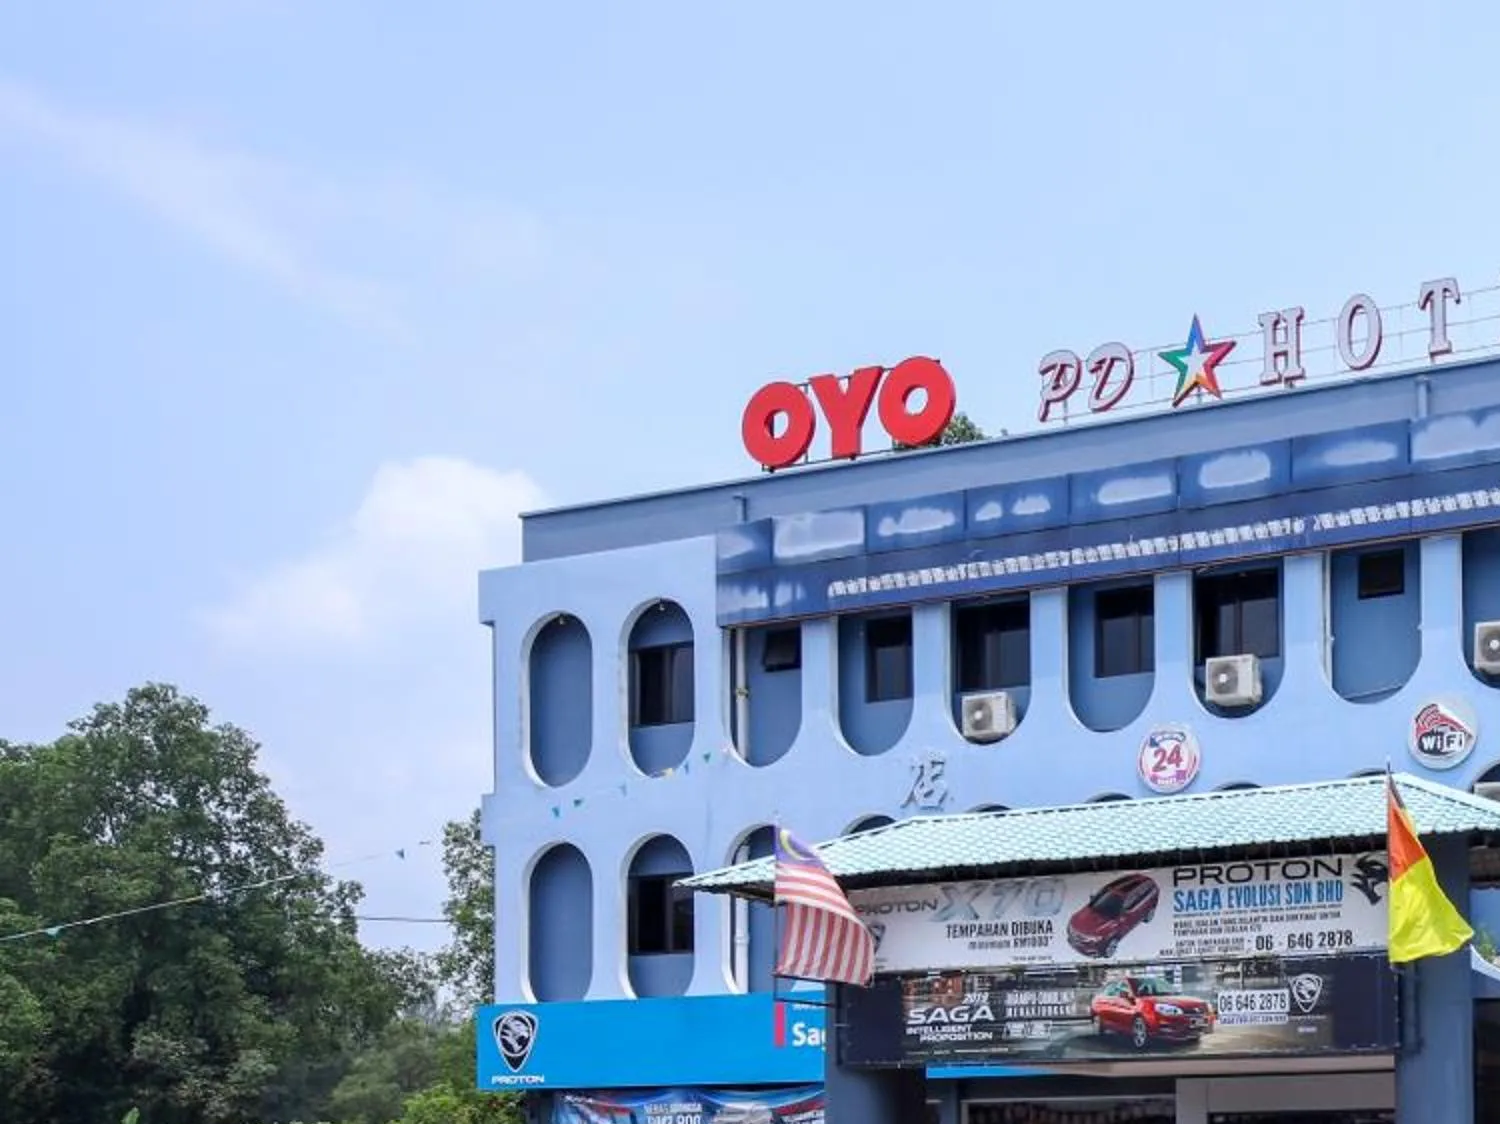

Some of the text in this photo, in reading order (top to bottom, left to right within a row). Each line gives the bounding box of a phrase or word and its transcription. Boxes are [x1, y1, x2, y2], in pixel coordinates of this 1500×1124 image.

[1038, 342, 1134, 422] PD
[741, 355, 956, 468] OYO
[1152, 744, 1183, 772] 24
[1173, 857, 1344, 887] PROTON
[1173, 887, 1222, 912] SAGA
[1227, 884, 1281, 908] EVOLUSI
[1285, 882, 1312, 905] SDN
[1316, 880, 1344, 902] BHD
[945, 919, 1053, 939] TEMPAHAN DIBUKA
[1255, 935, 1273, 951] 06
[1287, 932, 1314, 949] 646
[1318, 929, 1353, 948] 2878
[907, 1005, 995, 1024] SAGA
[1236, 994, 1256, 1011] 646
[1259, 992, 1287, 1010] 2878
